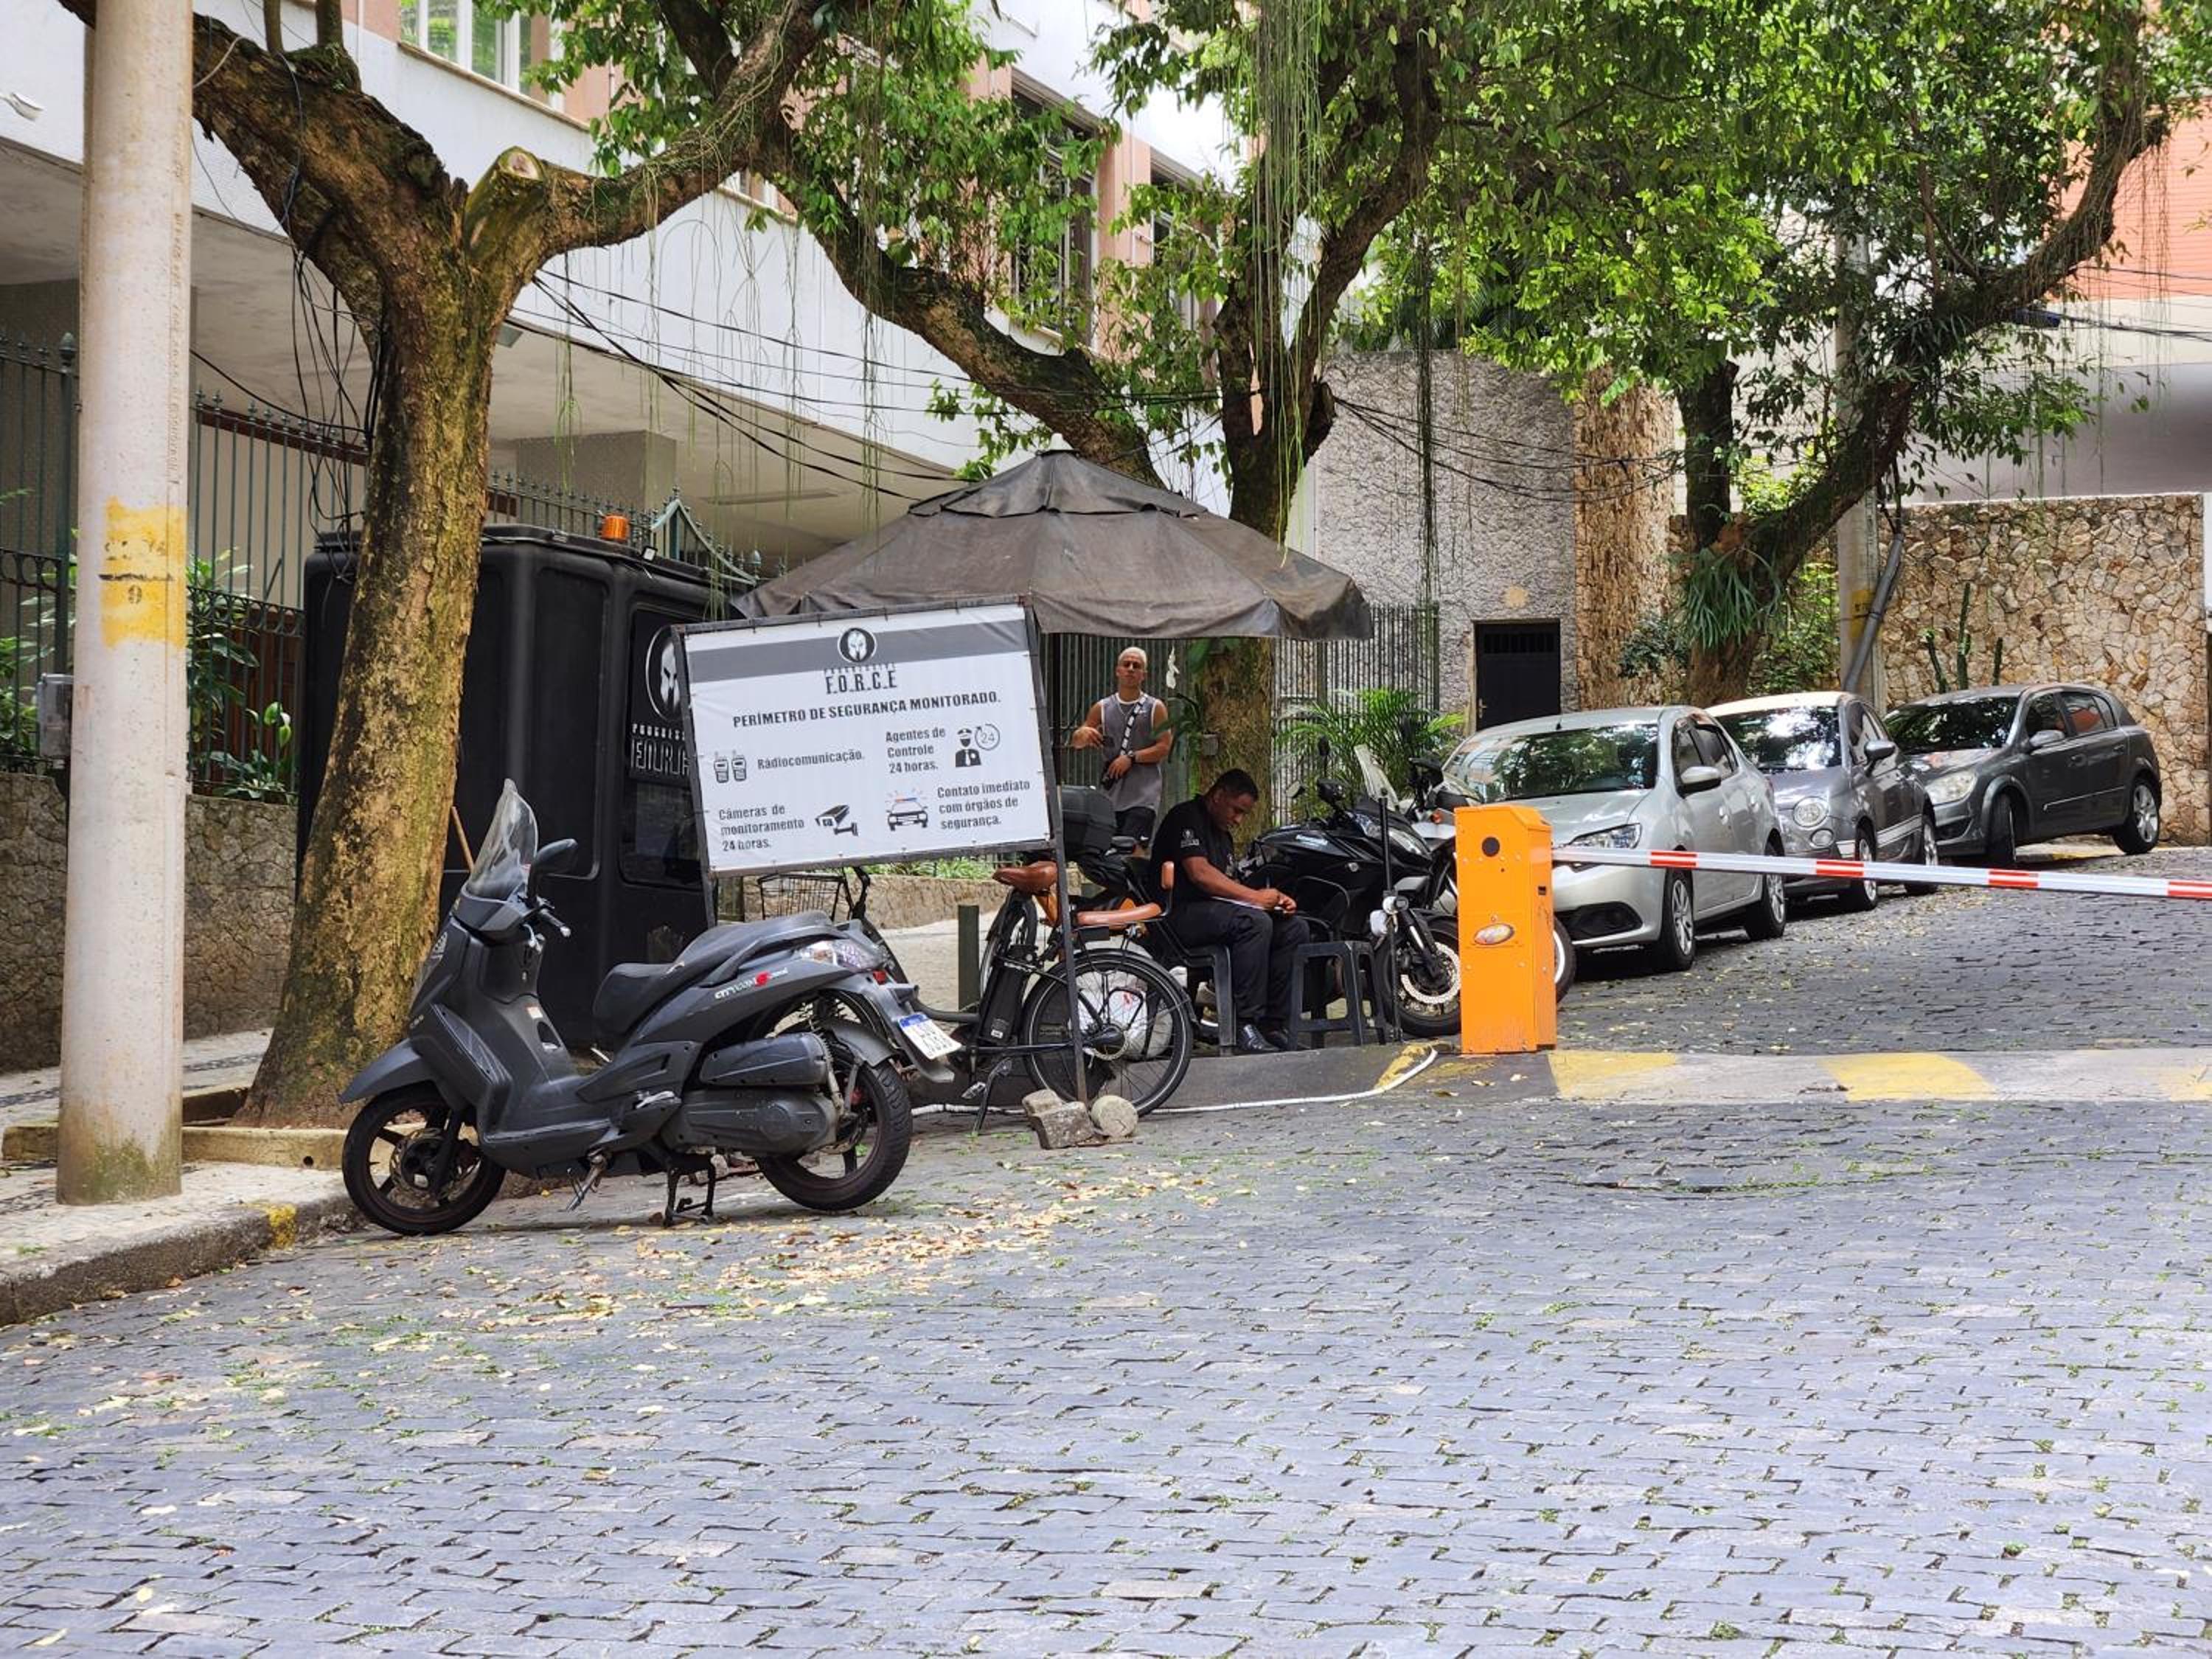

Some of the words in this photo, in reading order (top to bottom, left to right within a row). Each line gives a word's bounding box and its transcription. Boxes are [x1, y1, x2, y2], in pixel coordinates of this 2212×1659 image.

[733, 709, 807, 728] PERÍMETRO
[810, 708, 827, 720] DE
[829, 700, 907, 718] SEGURANÇA
[910, 691, 1001, 711] MONITORADO.
[886, 728, 930, 744] Agentes
[932, 727, 946, 738] de
[981, 732, 995, 744] 24
[887, 745, 934, 759] Controle
[888, 762, 902, 774] 24
[905, 760, 939, 773] horas.
[937, 785, 980, 799] Contato
[982, 780, 1030, 794] imediato
[719, 805, 768, 821] Câmeras
[772, 804, 785, 815] de
[939, 803, 962, 814] com
[965, 799, 1003, 813] órgãos
[1006, 796, 1018, 807] de
[721, 818, 805, 836] monitoramento
[941, 815, 1002, 830] segurança.
[723, 840, 736, 852] 24
[738, 838, 771, 851] horas.
